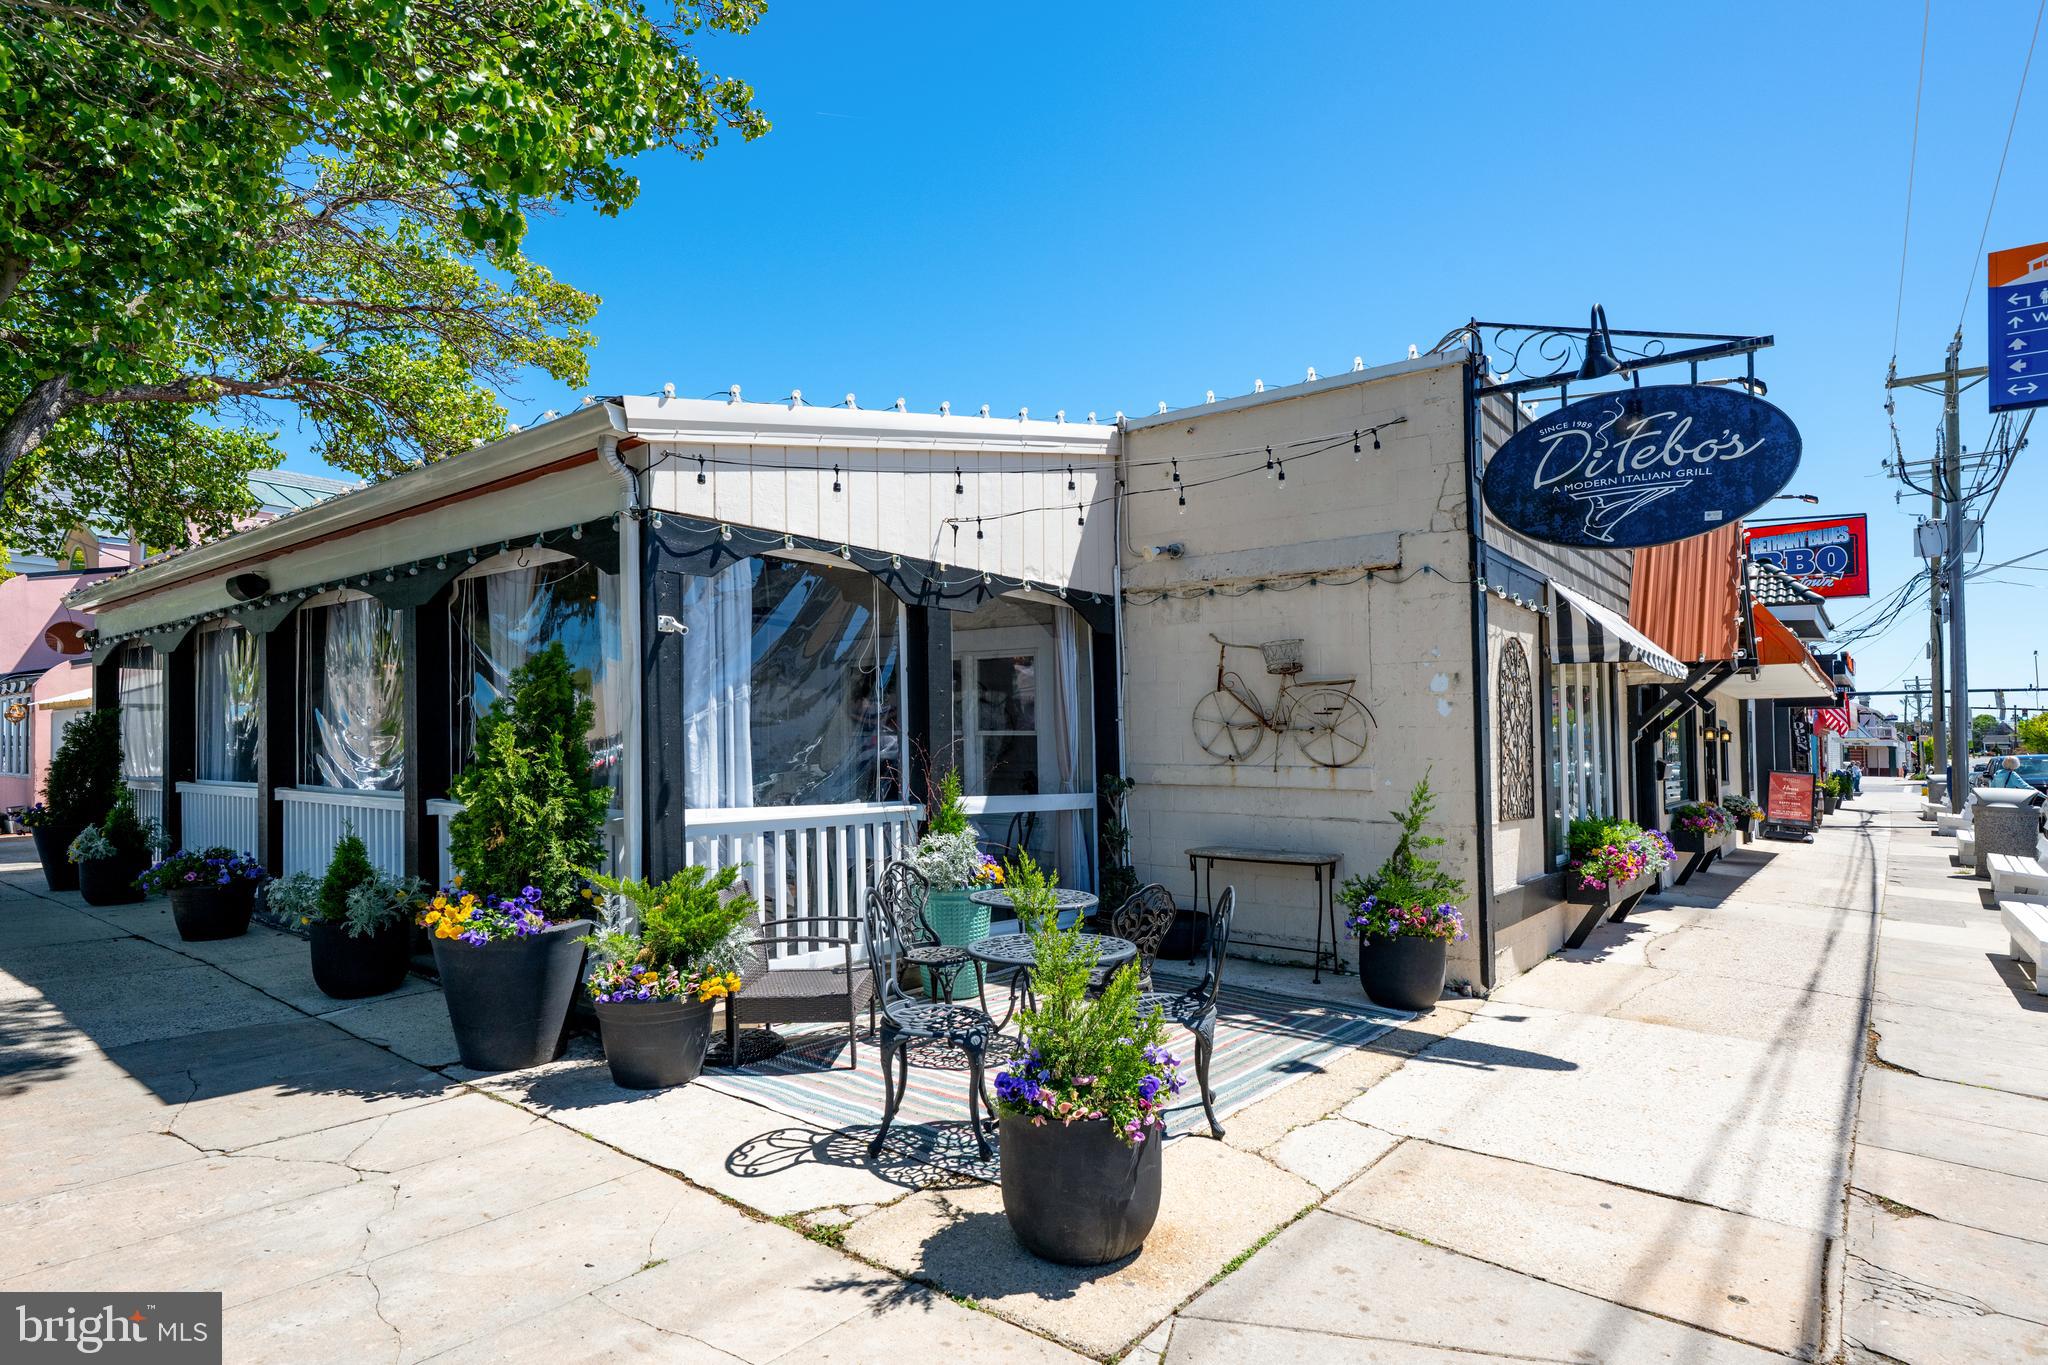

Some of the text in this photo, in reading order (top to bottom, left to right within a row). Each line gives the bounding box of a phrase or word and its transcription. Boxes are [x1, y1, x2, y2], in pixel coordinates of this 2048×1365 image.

[1539, 421, 1593, 436] SINCE 1989
[1552, 467, 1713, 494] A MODERN ITALIAN GRILL
[1750, 526, 1850, 554] BETHANY BLUES
